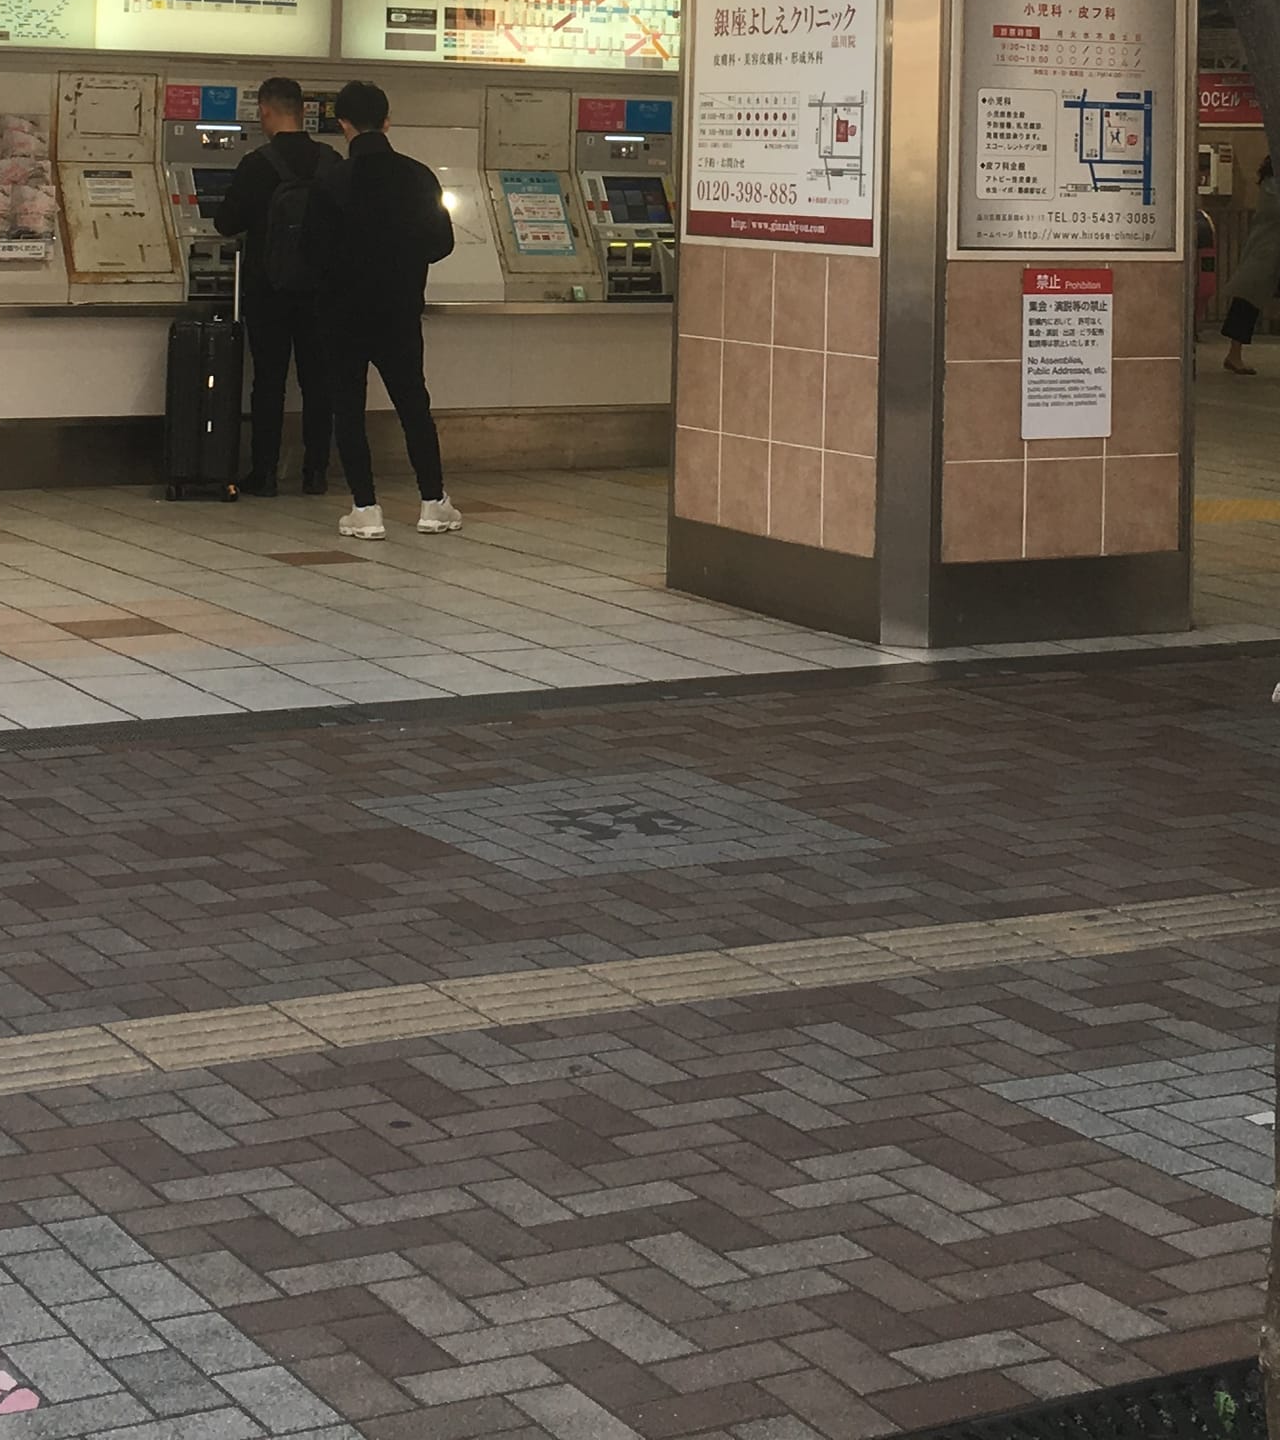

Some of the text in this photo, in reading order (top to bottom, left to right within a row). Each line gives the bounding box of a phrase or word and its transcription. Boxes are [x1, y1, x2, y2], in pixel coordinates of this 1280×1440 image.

[1023, 2, 1117, 20] 小児科・皮フ科
[713, 3, 857, 38] 銀座よしえクリニック
[830, 35, 857, 49] 品川院
[1199, 91, 1241, 108] OCビル
[697, 179, 798, 206] 0120-398-885
[1036, 273, 1061, 290] 禁止
[1027, 356, 1039, 365] No
